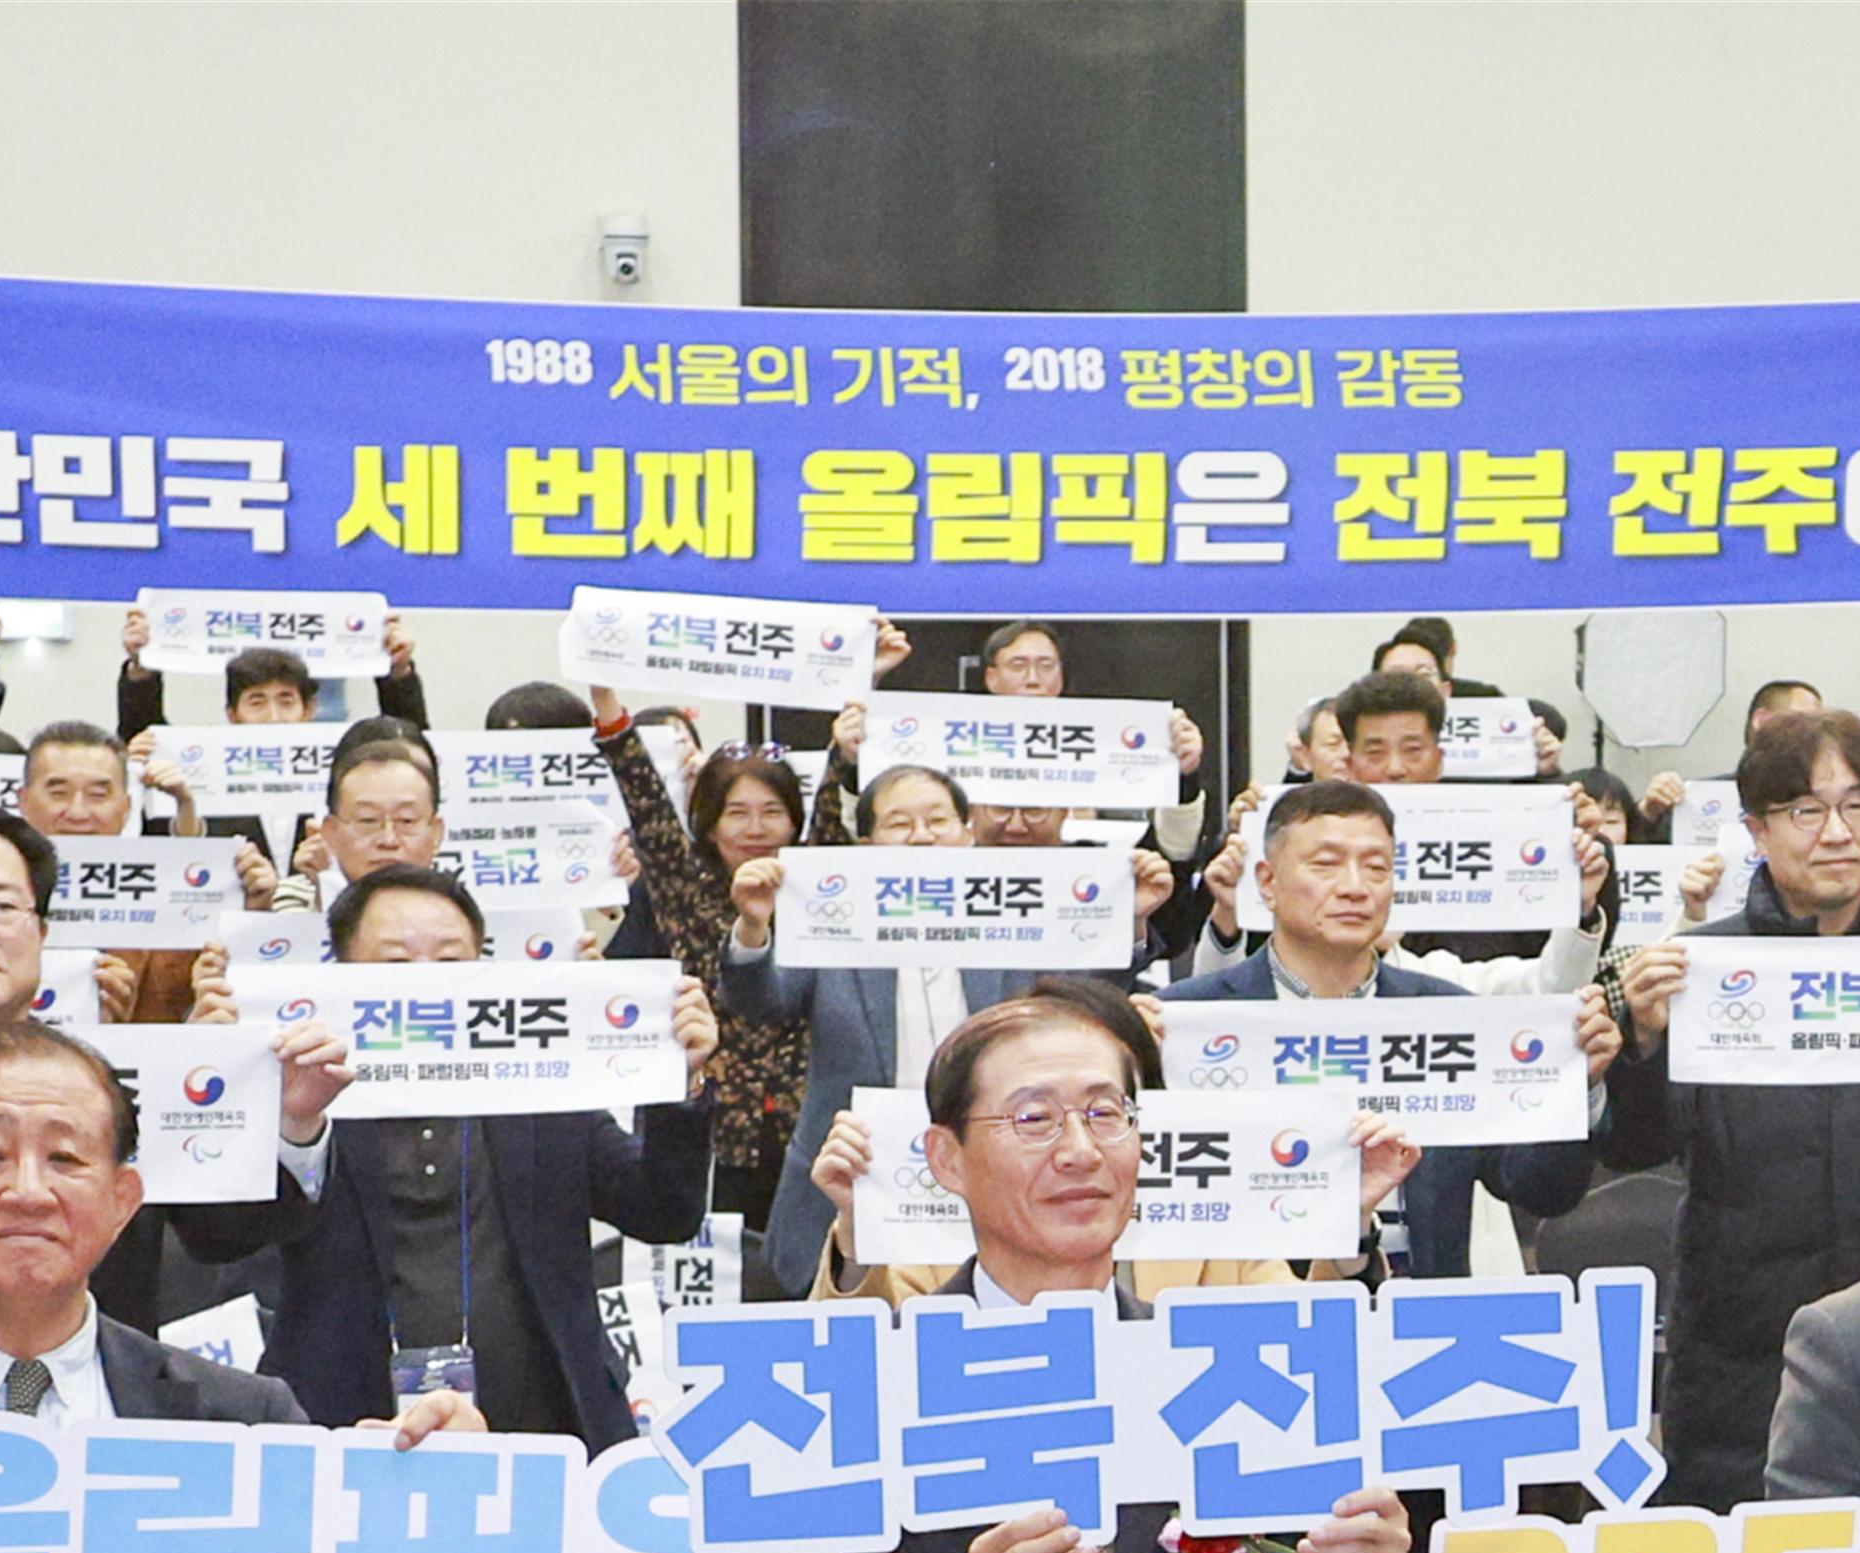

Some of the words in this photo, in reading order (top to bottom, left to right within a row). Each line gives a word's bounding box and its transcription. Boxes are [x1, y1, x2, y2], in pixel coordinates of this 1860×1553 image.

[487, 340, 592, 384] 1988
[611, 344, 807, 405] 서울의
[833, 348, 978, 409] 기적,
[1005, 348, 1104, 390] 2018
[1121, 349, 1313, 408] 평창의
[1337, 350, 1462, 407] 감동
[337, 445, 457, 553] 세
[507, 448, 753, 558] 번째
[799, 451, 1288, 562] 올림픽은
[1334, 450, 1566, 560] 전북
[206, 611, 262, 638] 전북
[269, 614, 324, 640] 전주
[647, 614, 717, 653] 전북
[725, 621, 794, 659] 전주
[945, 721, 1016, 758] 전북
[1024, 724, 1095, 761] 전주
[225, 747, 283, 775] 전북
[466, 755, 534, 788] 전북
[541, 751, 609, 786] 전주
[1417, 842, 1492, 880] 전주
[79, 863, 156, 900] 전주
[876, 877, 955, 917] 전북
[964, 877, 1043, 917] 전주
[984, 927, 1012, 941] 유치
[353, 1000, 456, 1050] 전북
[467, 998, 569, 1049] 전주
[356, 1063, 489, 1082] 올림픽·패럴림픽
[494, 1062, 529, 1079] 유치
[534, 1061, 570, 1078] 희망
[1273, 1035, 1371, 1084] 전북
[1380, 1034, 1476, 1082] 전주
[1405, 1095, 1438, 1112] 유치
[1443, 1094, 1476, 1111] 희망
[1139, 1132, 1231, 1189] 전주
[1147, 1203, 1185, 1222] 유치
[1191, 1202, 1231, 1222] 희망
[665, 1308, 1113, 1547] 전북
[1161, 1281, 1650, 1519] 전주!
